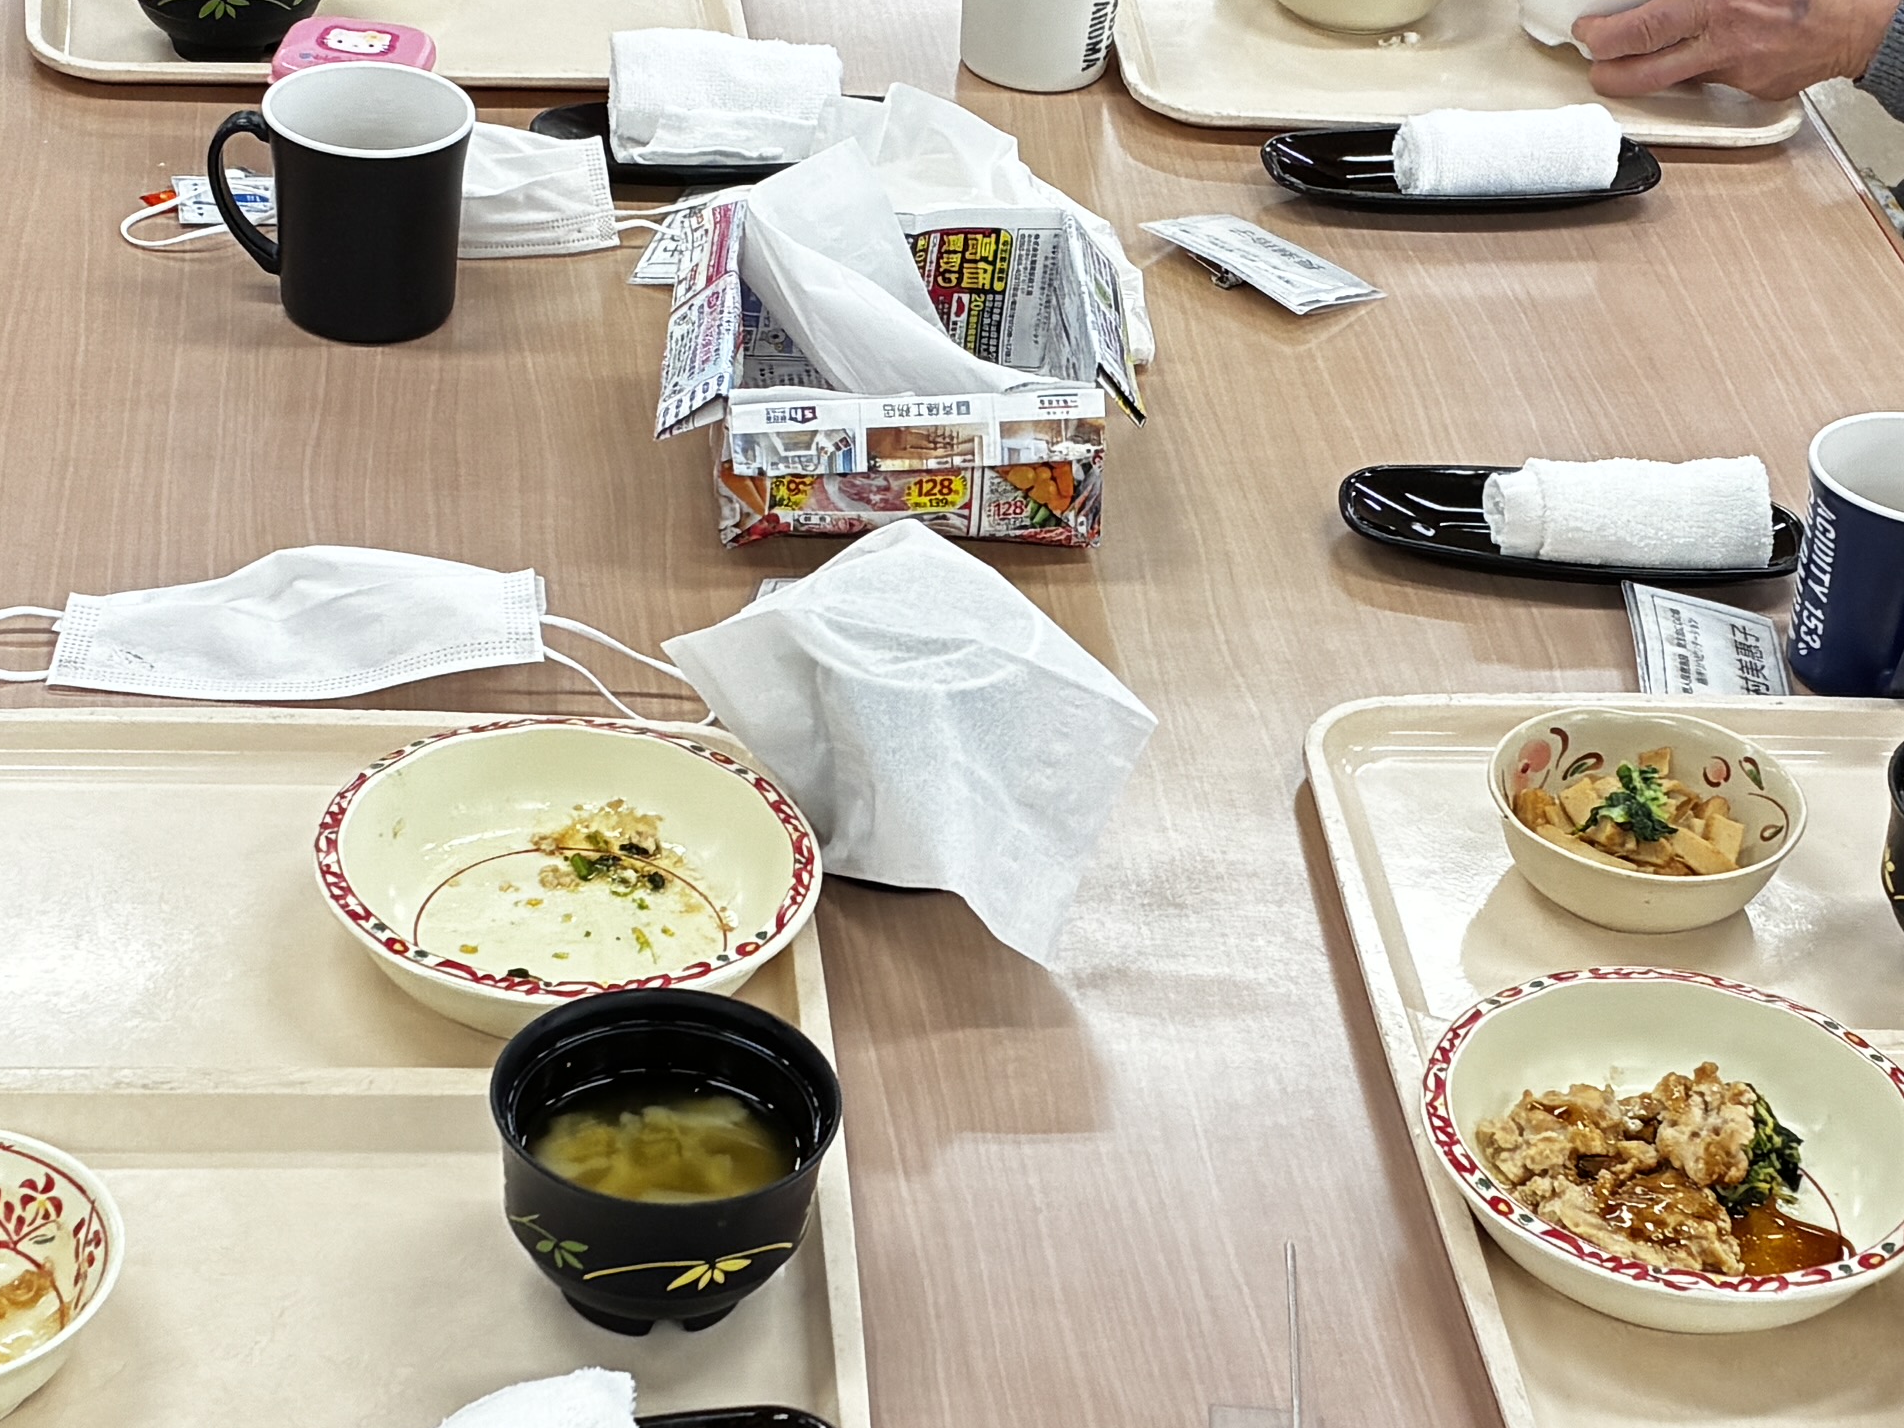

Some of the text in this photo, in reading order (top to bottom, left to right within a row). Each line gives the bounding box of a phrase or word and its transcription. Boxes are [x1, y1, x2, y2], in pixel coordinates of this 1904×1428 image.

[1081, 1, 1111, 72] AROMA
[937, 232, 964, 288] 買取り
[961, 232, 997, 290] 高価
[913, 477, 954, 498] 128
[992, 499, 1026, 519] 128
[1807, 497, 1838, 604] ACIDITY
